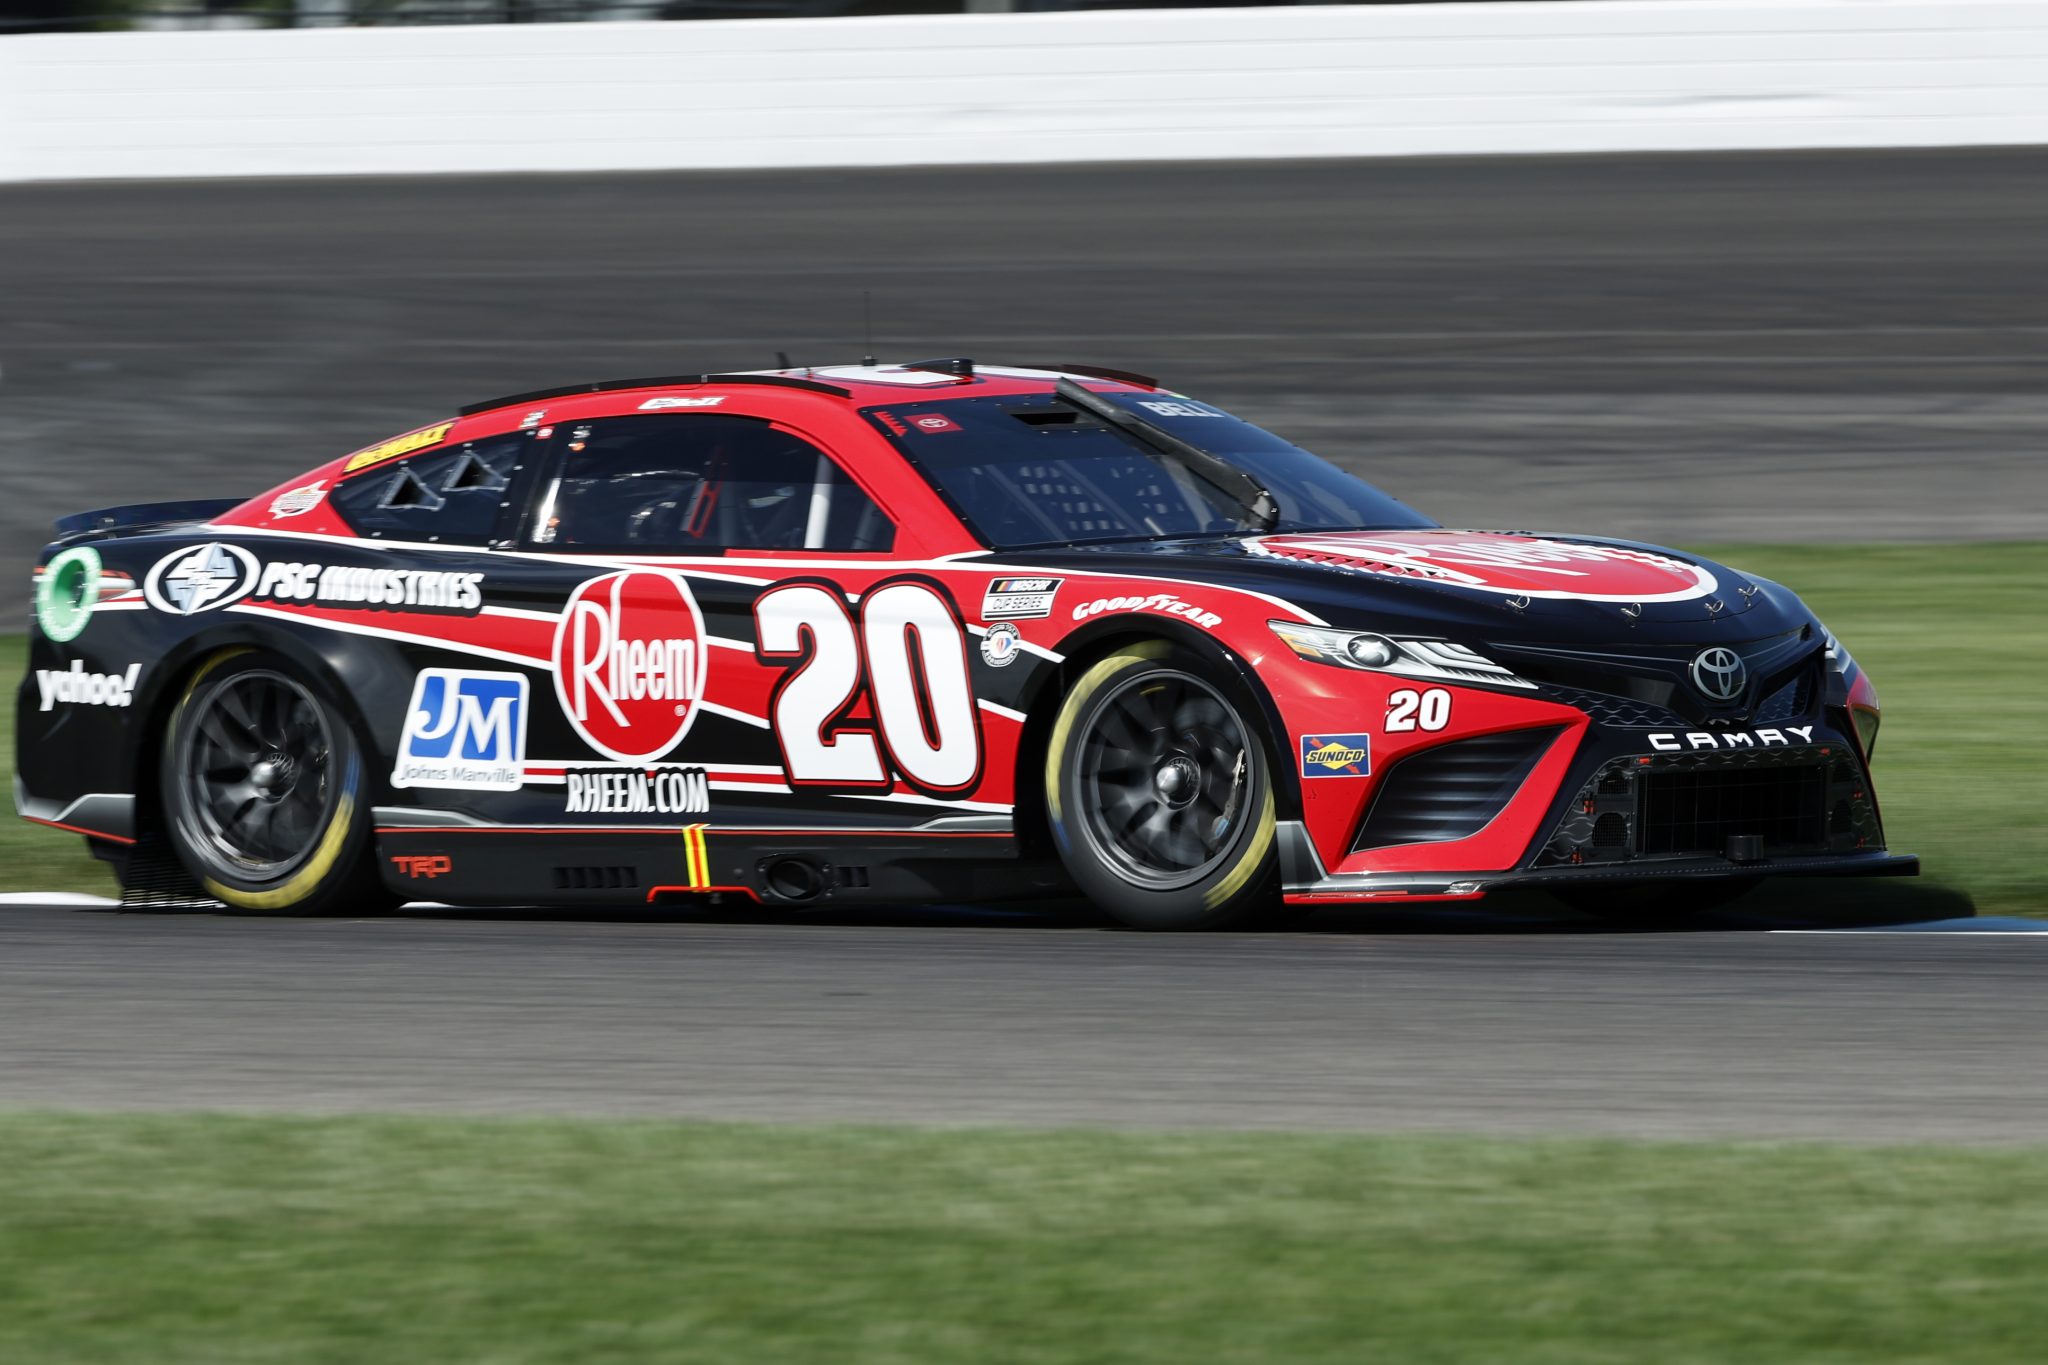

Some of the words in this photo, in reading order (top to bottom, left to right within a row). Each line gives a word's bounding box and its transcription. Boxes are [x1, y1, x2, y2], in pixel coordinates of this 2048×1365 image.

[1136, 401, 1225, 418] BELL
[256, 562, 322, 599] PSC
[317, 566, 485, 609] INDUSTRIES
[1072, 594, 1222, 629] GOODYEAR
[574, 574, 696, 727] Rheem
[36, 659, 142, 711] yahoo!
[752, 580, 980, 786] 20
[410, 672, 519, 762] JM
[1384, 688, 1451, 732] 20
[400, 764, 448, 781] Johns
[1308, 751, 1362, 762] SUNOCO
[391, 856, 452, 878] TRD
